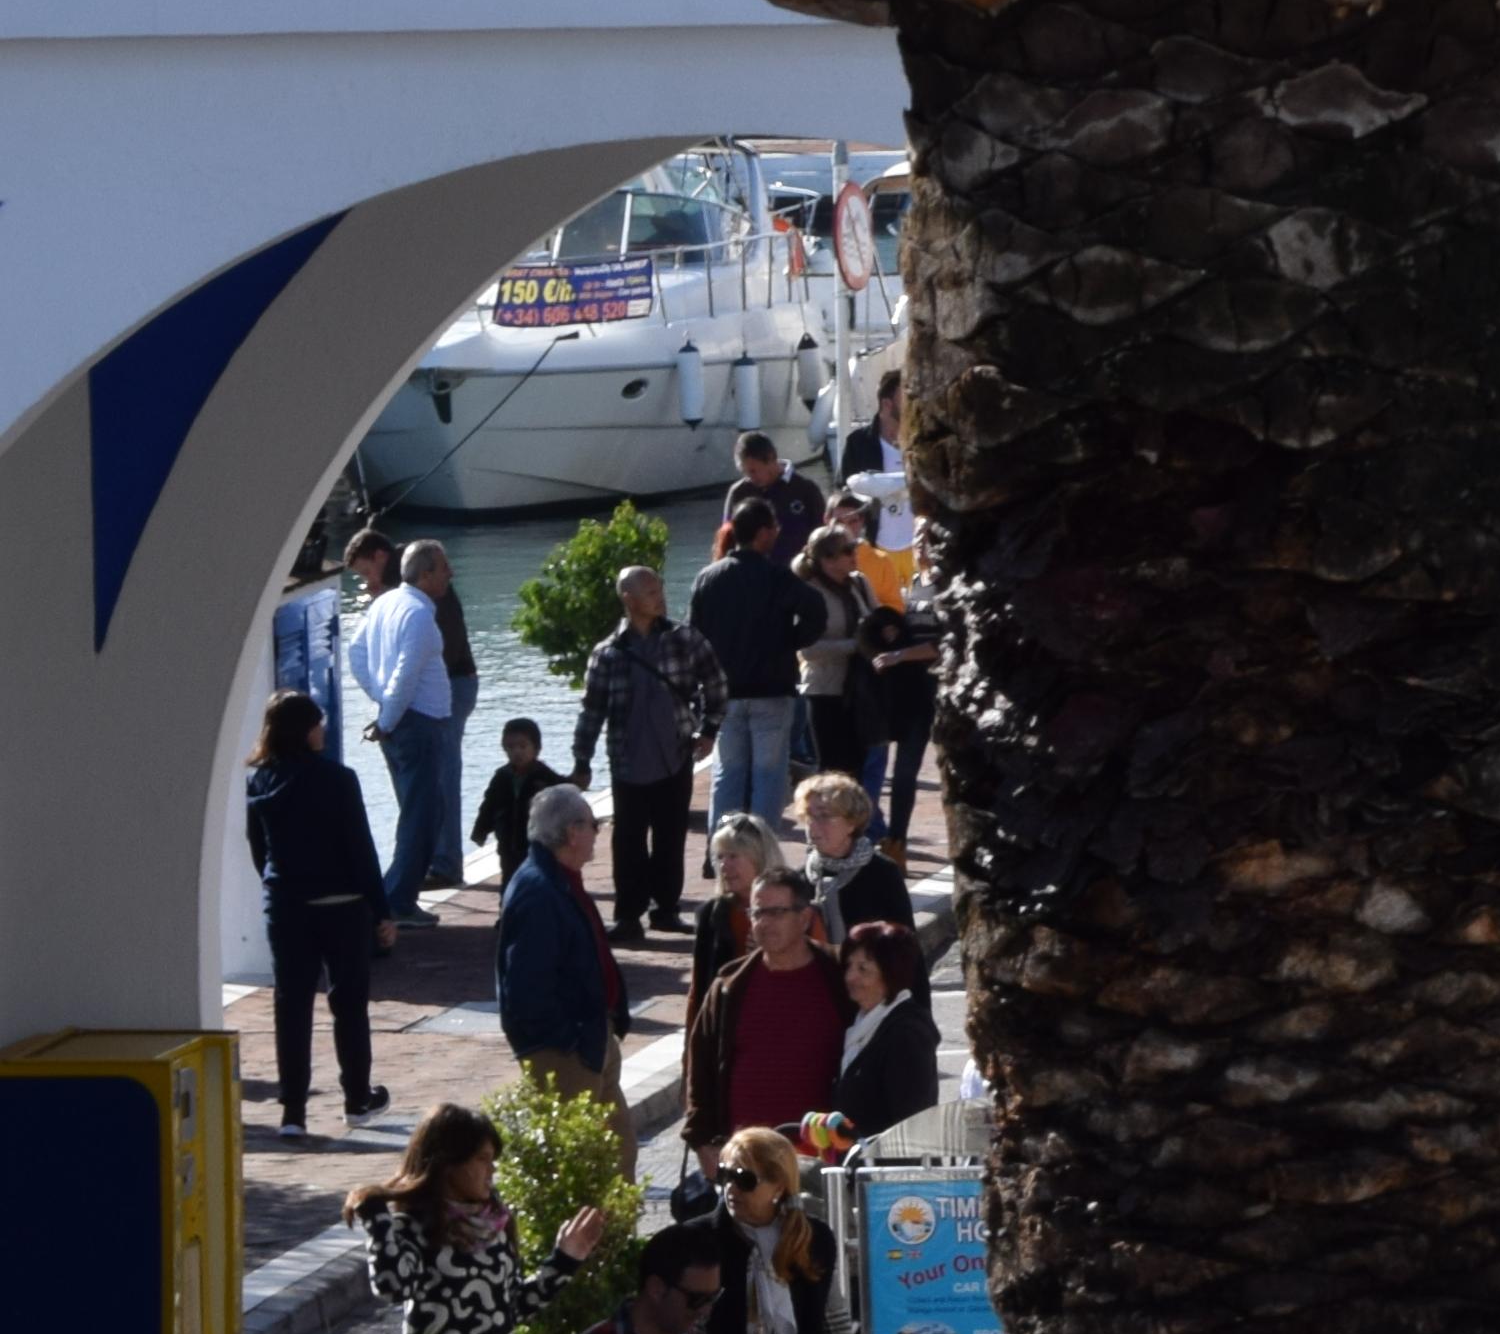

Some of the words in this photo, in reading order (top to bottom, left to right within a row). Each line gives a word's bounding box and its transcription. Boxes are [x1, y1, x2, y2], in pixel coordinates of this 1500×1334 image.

[501, 279, 538, 305] 150
[897, 1262, 947, 1290] Your
[953, 1254, 986, 1274] On
[953, 1282, 980, 1294] CAR
